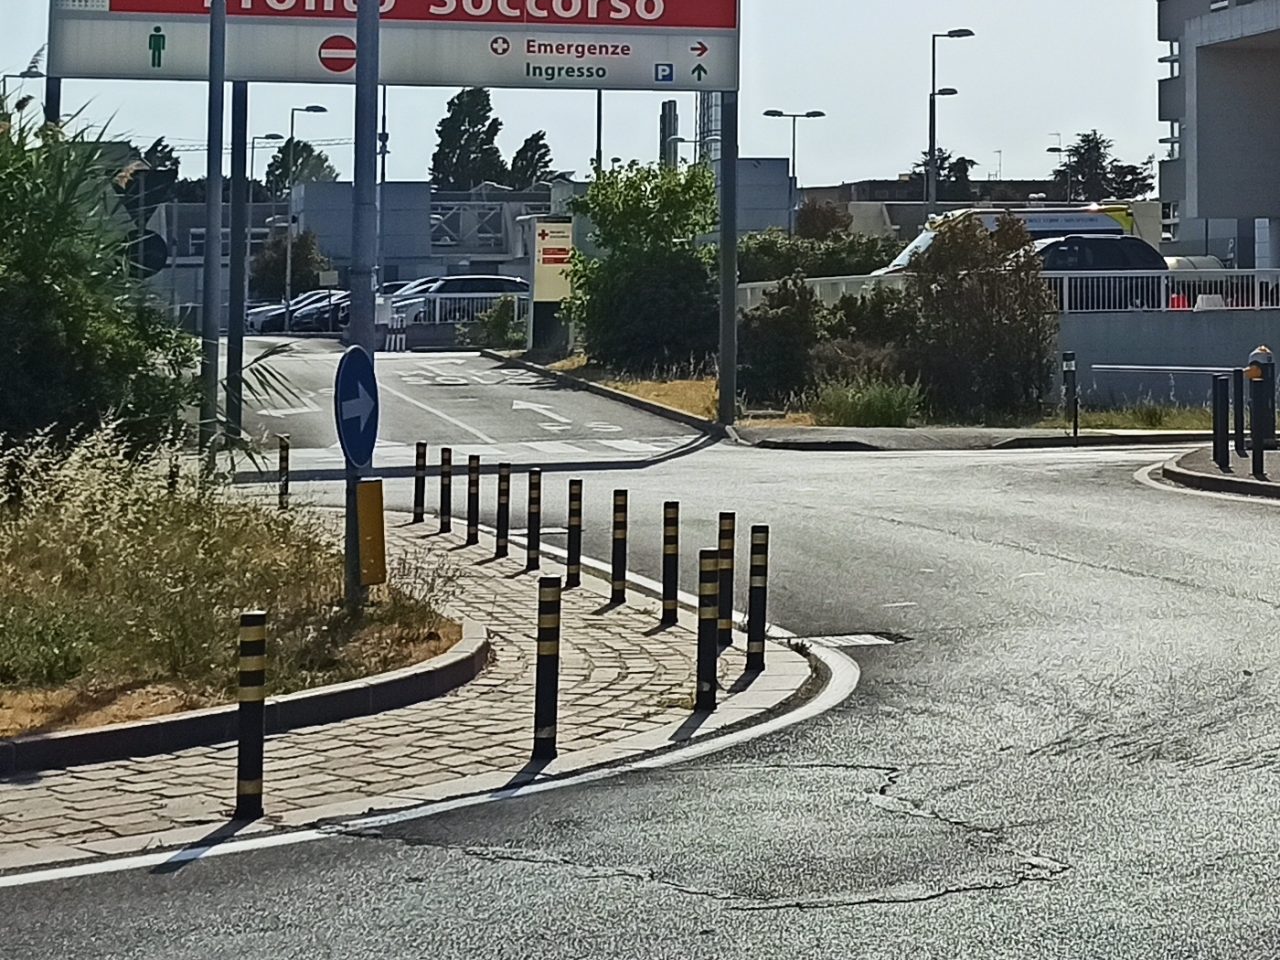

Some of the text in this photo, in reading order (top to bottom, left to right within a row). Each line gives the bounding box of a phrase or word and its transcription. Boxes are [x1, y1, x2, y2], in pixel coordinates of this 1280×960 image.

[526, 39, 631, 58] Emergenze
[525, 62, 607, 82] Ingresso
[657, 65, 671, 79] P
